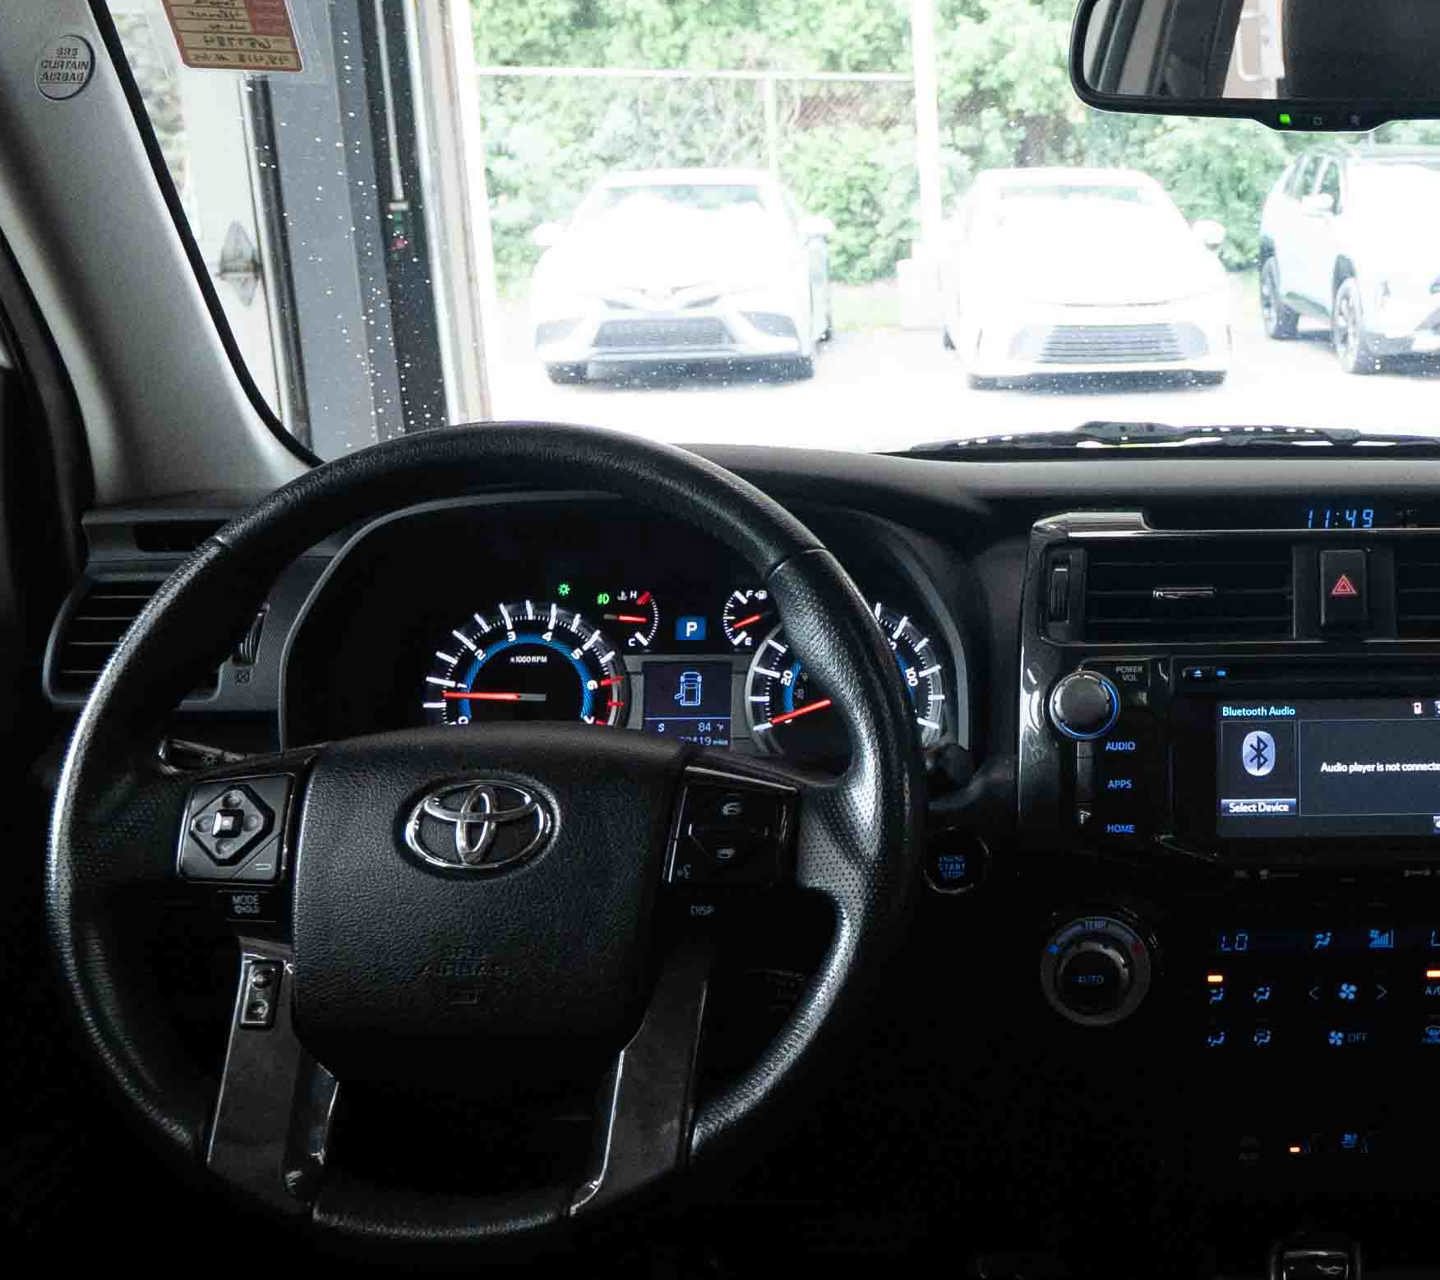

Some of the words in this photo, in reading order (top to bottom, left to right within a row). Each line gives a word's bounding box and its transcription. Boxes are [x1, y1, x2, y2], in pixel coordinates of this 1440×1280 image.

[40, 60, 90, 70] CURTAIN
[40, 71, 85, 81] AIRBAG
[1308, 509, 1374, 528] 11:49
[629, 591, 638, 600] H
[686, 621, 698, 637] P
[507, 631, 517, 641] 3
[543, 631, 553, 642] 4
[628, 637, 637, 647] C
[476, 649, 486, 661] 2
[571, 649, 583, 660] 5
[780, 669, 794, 687] 20
[905, 666, 919, 687] 100
[587, 680, 598, 690] 6
[1222, 706, 1267, 718] Bluetooth
[1269, 706, 1296, 717] Audio
[657, 722, 665, 733] S
[697, 721, 711, 733] 84
[1105, 741, 1137, 751] AUDIO
[1320, 762, 1347, 772] Audio
[1349, 762, 1376, 774] player
[1377, 762, 1384, 771] is
[1385, 762, 1400, 771] not
[1107, 779, 1133, 789] APPS
[1229, 803, 1257, 813] Select
[1258, 803, 1289, 813] Device
[1106, 823, 1137, 833] HOME
[232, 895, 260, 905] MODE
[1347, 1032, 1368, 1043] OFF
